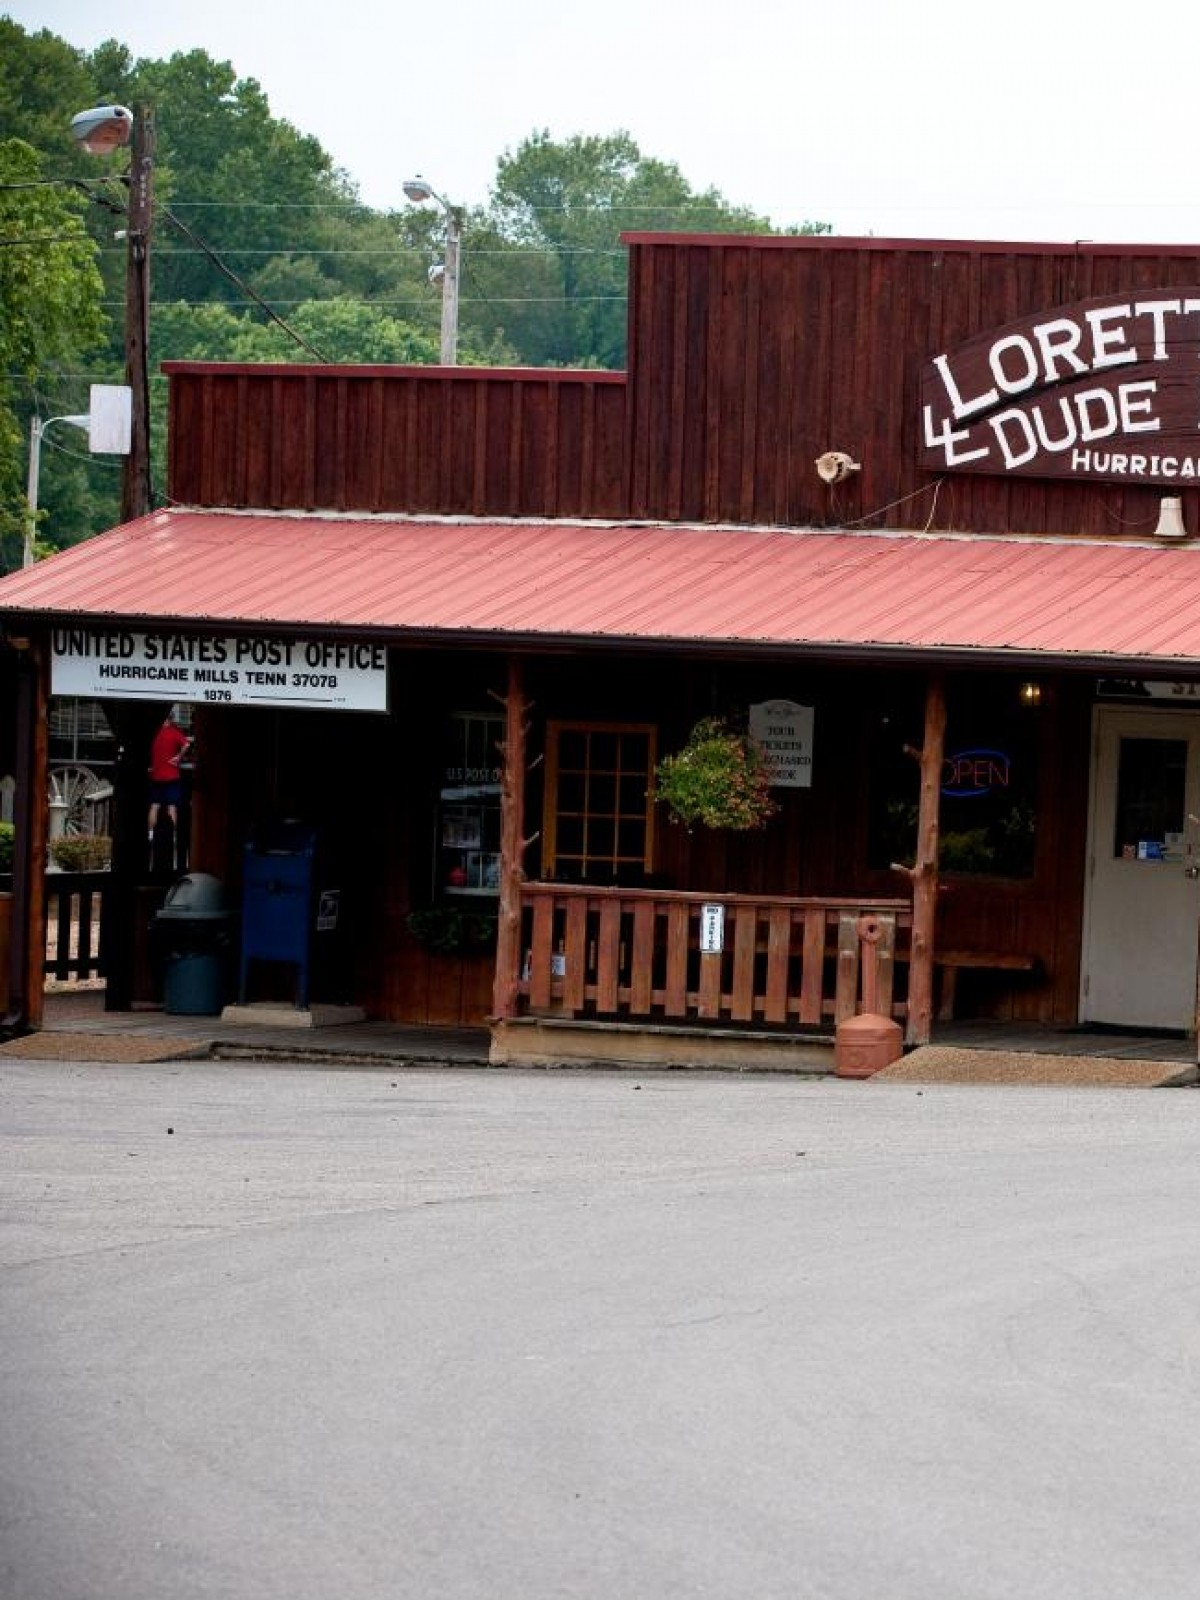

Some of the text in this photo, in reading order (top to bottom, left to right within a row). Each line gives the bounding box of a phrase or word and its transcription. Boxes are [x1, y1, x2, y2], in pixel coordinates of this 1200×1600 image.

[988, 380, 1161, 470] DUDE
[52, 630, 385, 670] UNITED STATES POST OFFICE
[99, 664, 338, 688] HURRICANE MILLS TENN 37078
[204, 689, 232, 701] 1876
